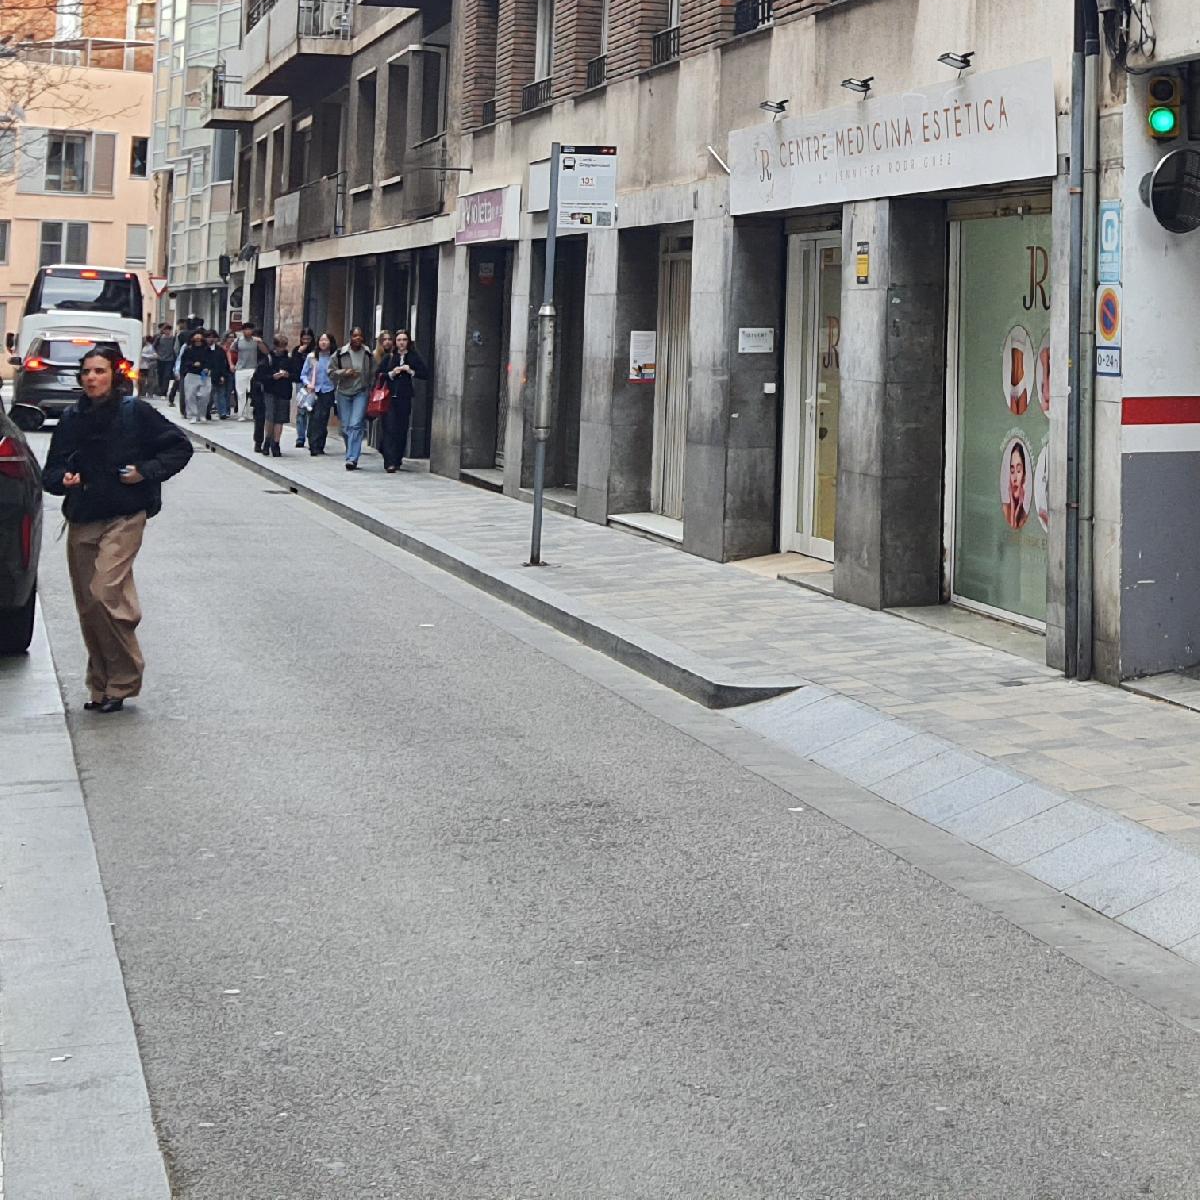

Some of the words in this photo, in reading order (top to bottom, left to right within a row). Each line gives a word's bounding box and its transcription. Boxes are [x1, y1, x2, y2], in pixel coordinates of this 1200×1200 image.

[779, 133, 828, 168] CENTRE
[836, 116, 913, 158] MEDICINA
[922, 96, 1009, 143] ESTÈTICA
[888, 152, 952, 174] RODRGUEZ
[1022, 245, 1051, 311] JR
